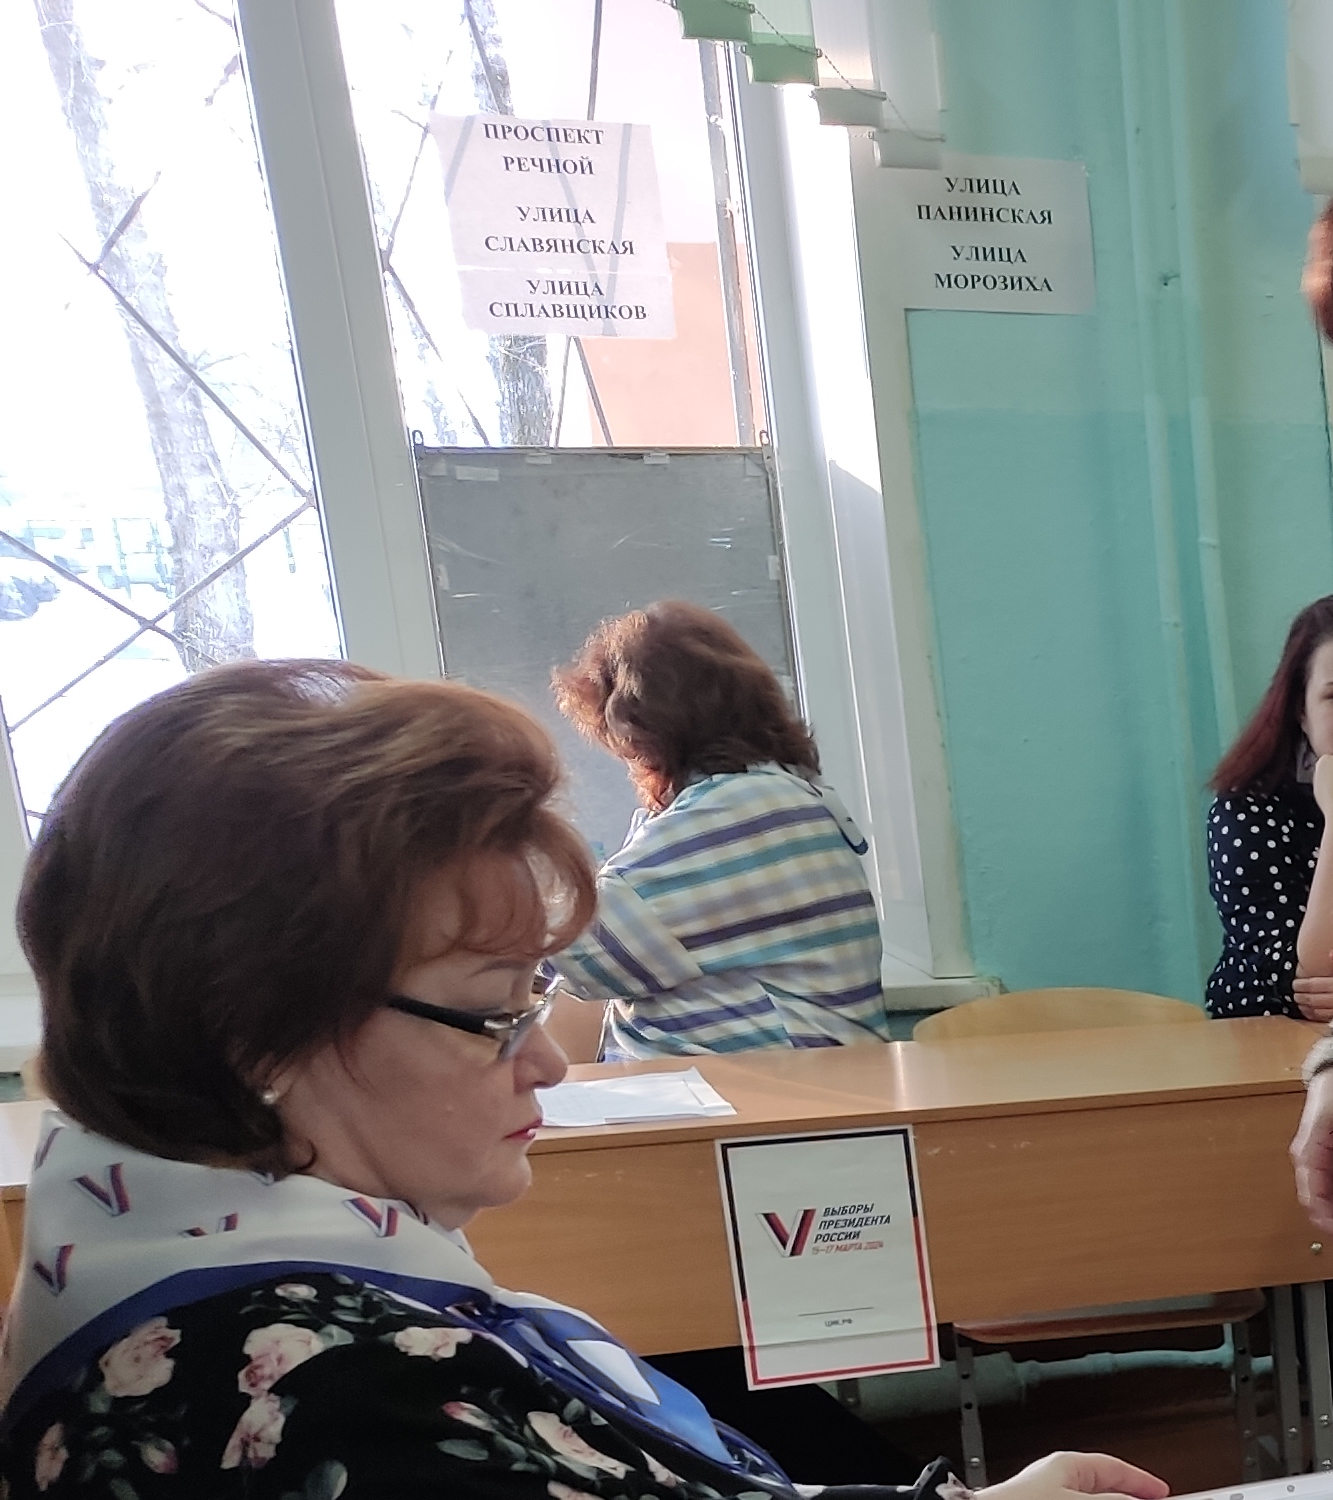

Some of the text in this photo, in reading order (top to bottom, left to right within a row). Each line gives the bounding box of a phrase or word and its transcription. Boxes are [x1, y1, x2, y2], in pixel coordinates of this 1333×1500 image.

[483, 123, 604, 145] ПРОСПЕКТ
[502, 155, 595, 175] РЕЧНОЙ
[945, 177, 1021, 197] УЛИЦА
[516, 206, 596, 225] УЛИЦА
[917, 205, 1053, 225] ПАНИНСКАЯ
[485, 235, 635, 255] СЛАВЯНСКАЯ
[951, 246, 1028, 264] УЛИЦА
[526, 279, 605, 298] УЛИЦА
[934, 273, 1053, 292] МОРОЗИХА
[489, 302, 647, 320] СПЛАВЩИКОВ
[823, 1203, 875, 1217] ВЫБОРЫ
[818, 1214, 891, 1230] ПРЕЗИДЕНТА
[814, 1230, 861, 1244] РОССИИ
